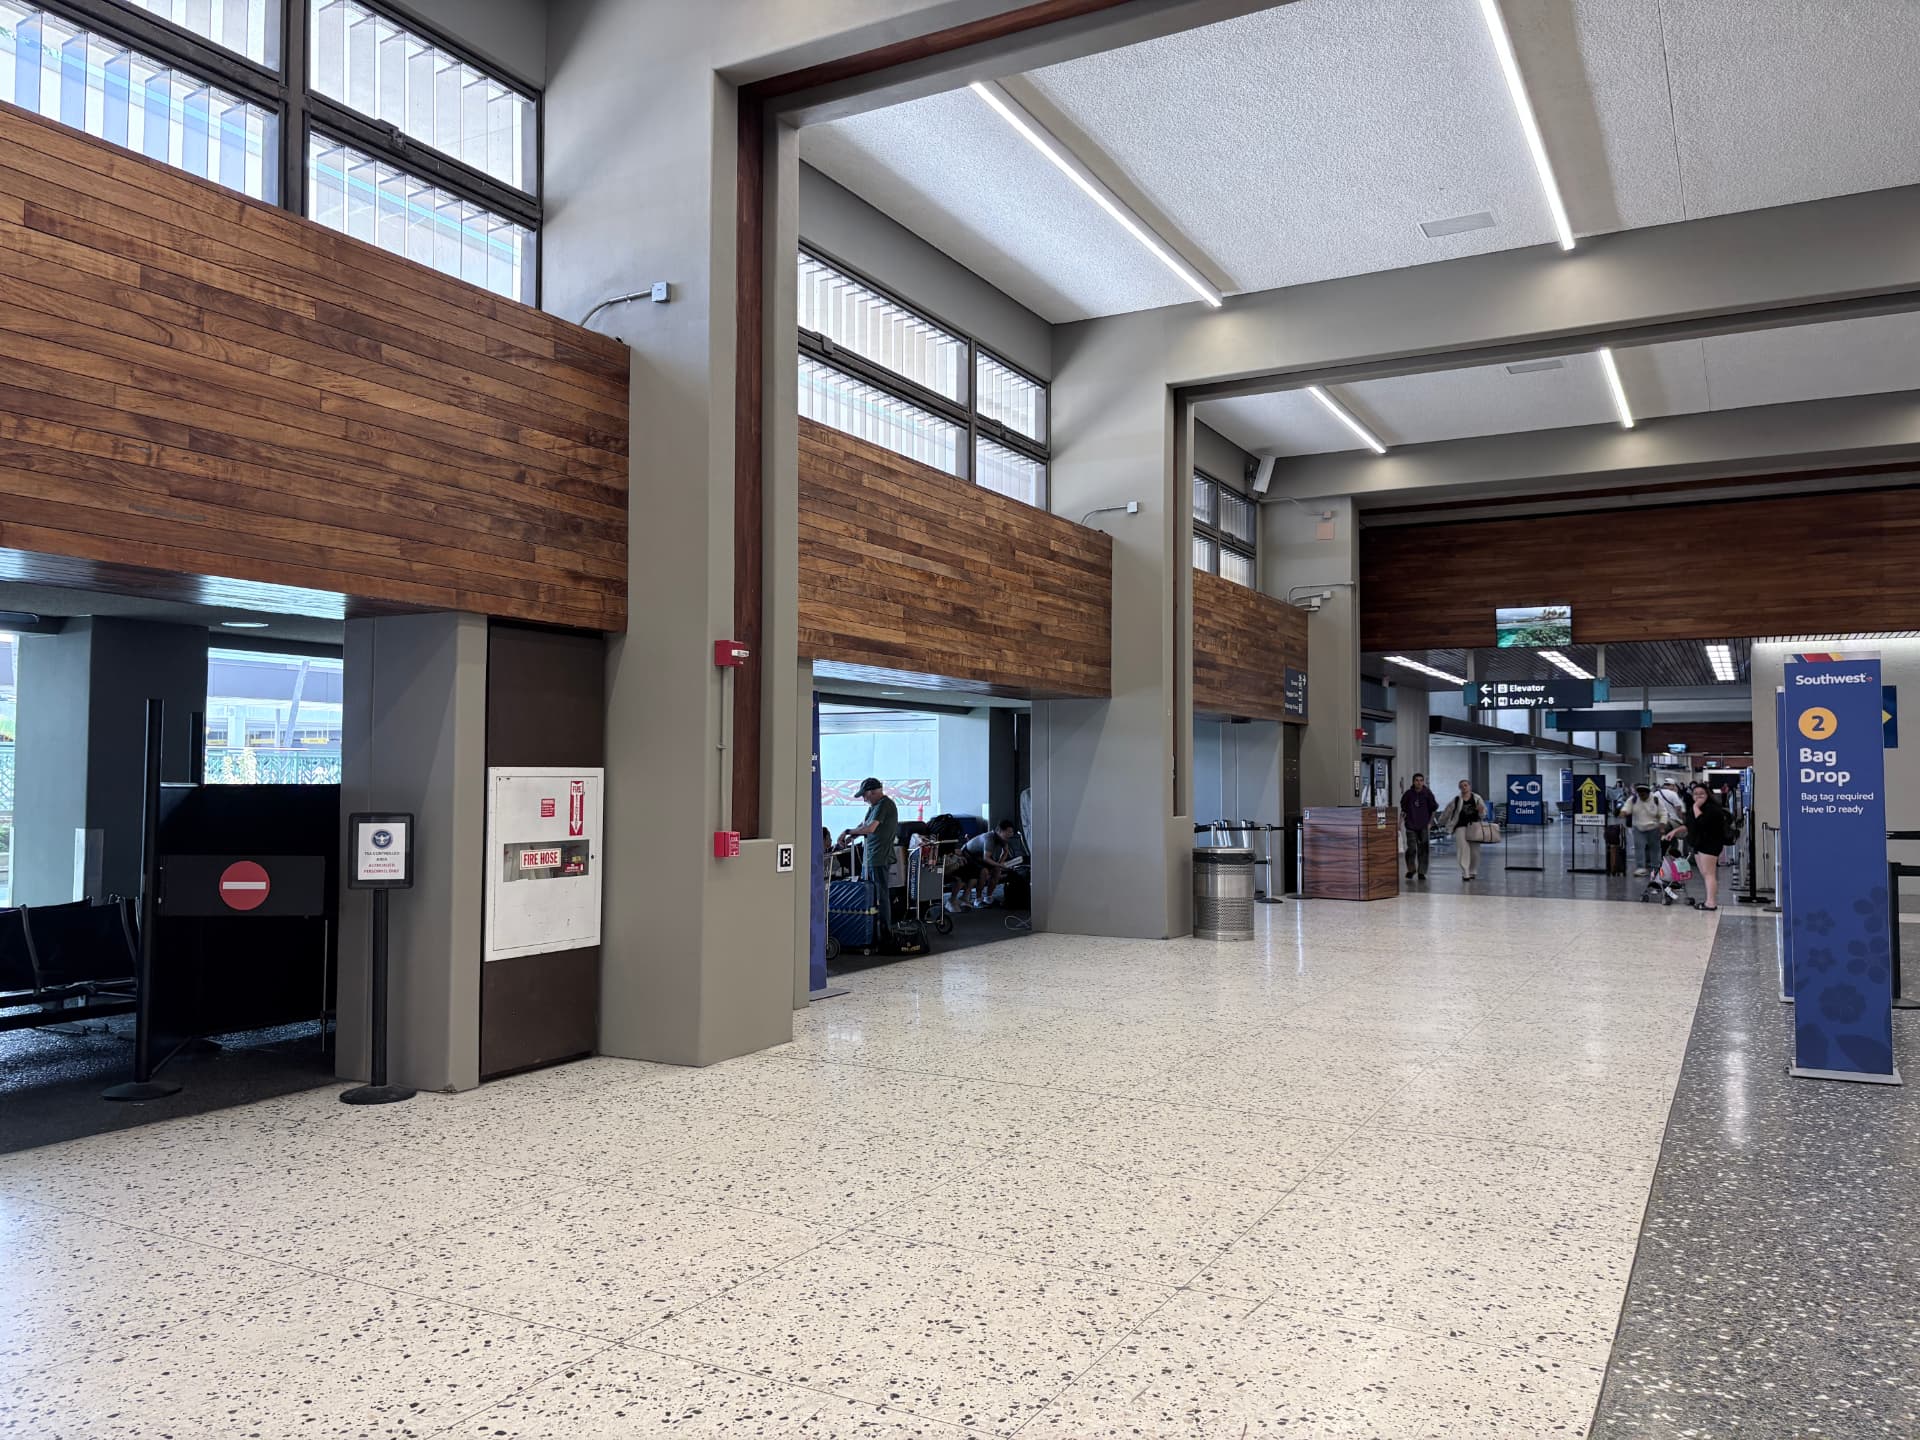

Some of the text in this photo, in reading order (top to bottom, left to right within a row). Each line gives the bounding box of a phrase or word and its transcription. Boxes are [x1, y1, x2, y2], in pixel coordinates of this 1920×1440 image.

[1795, 673, 1867, 685] Southwest
[1509, 684, 1545, 693] Elevator
[1509, 697, 1536, 706] Lobby
[1811, 715, 1825, 731] 2
[1800, 748, 1836, 766] Bag
[1800, 769, 1850, 786] Drop
[1801, 792, 1874, 802] Bag tag required
[1585, 801, 1594, 812] 5
[1801, 805, 1864, 815] Have ID ready
[523, 851, 558, 866] FIRE HOSE
